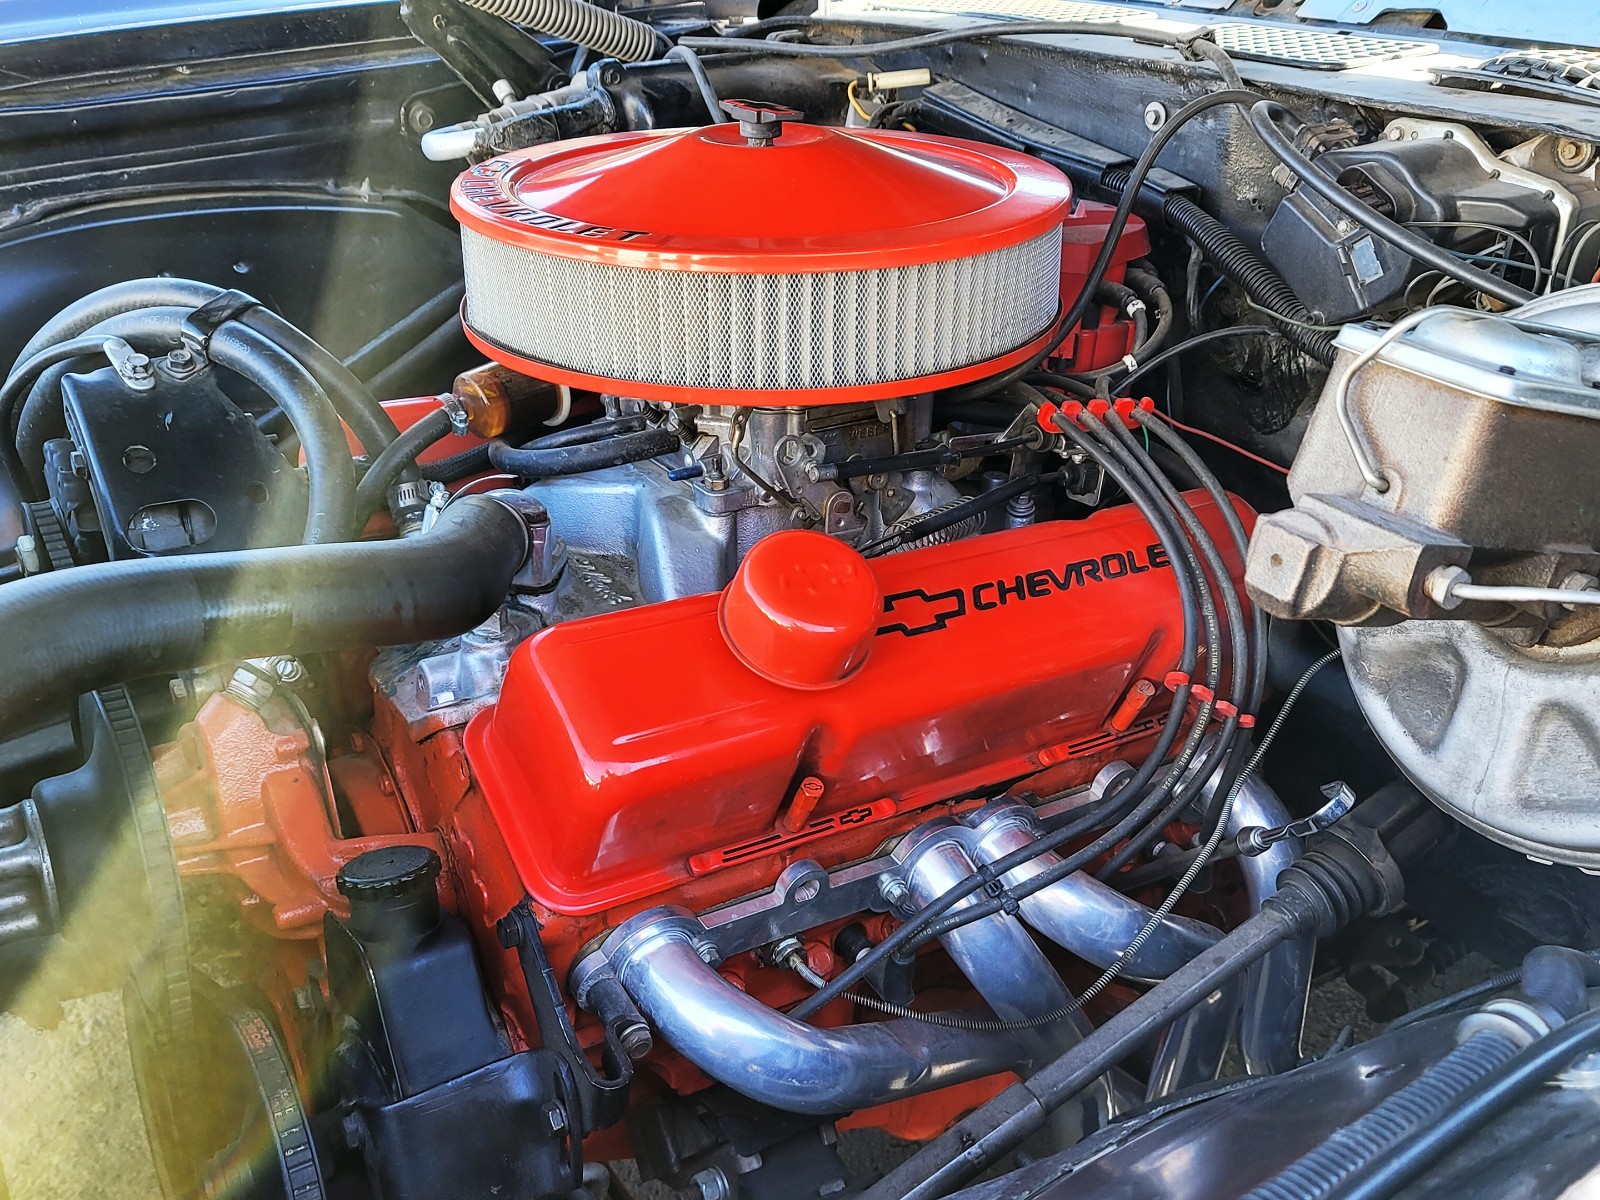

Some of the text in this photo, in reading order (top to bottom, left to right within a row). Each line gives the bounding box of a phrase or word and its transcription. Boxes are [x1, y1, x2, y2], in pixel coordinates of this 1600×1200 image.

[461, 179, 650, 241] CHEVROLET
[972, 543, 1171, 611] CHEVROLE
[1178, 748, 1192, 767] MADE
[1172, 767, 1181, 777] IN
[1161, 777, 1174, 790] USA
